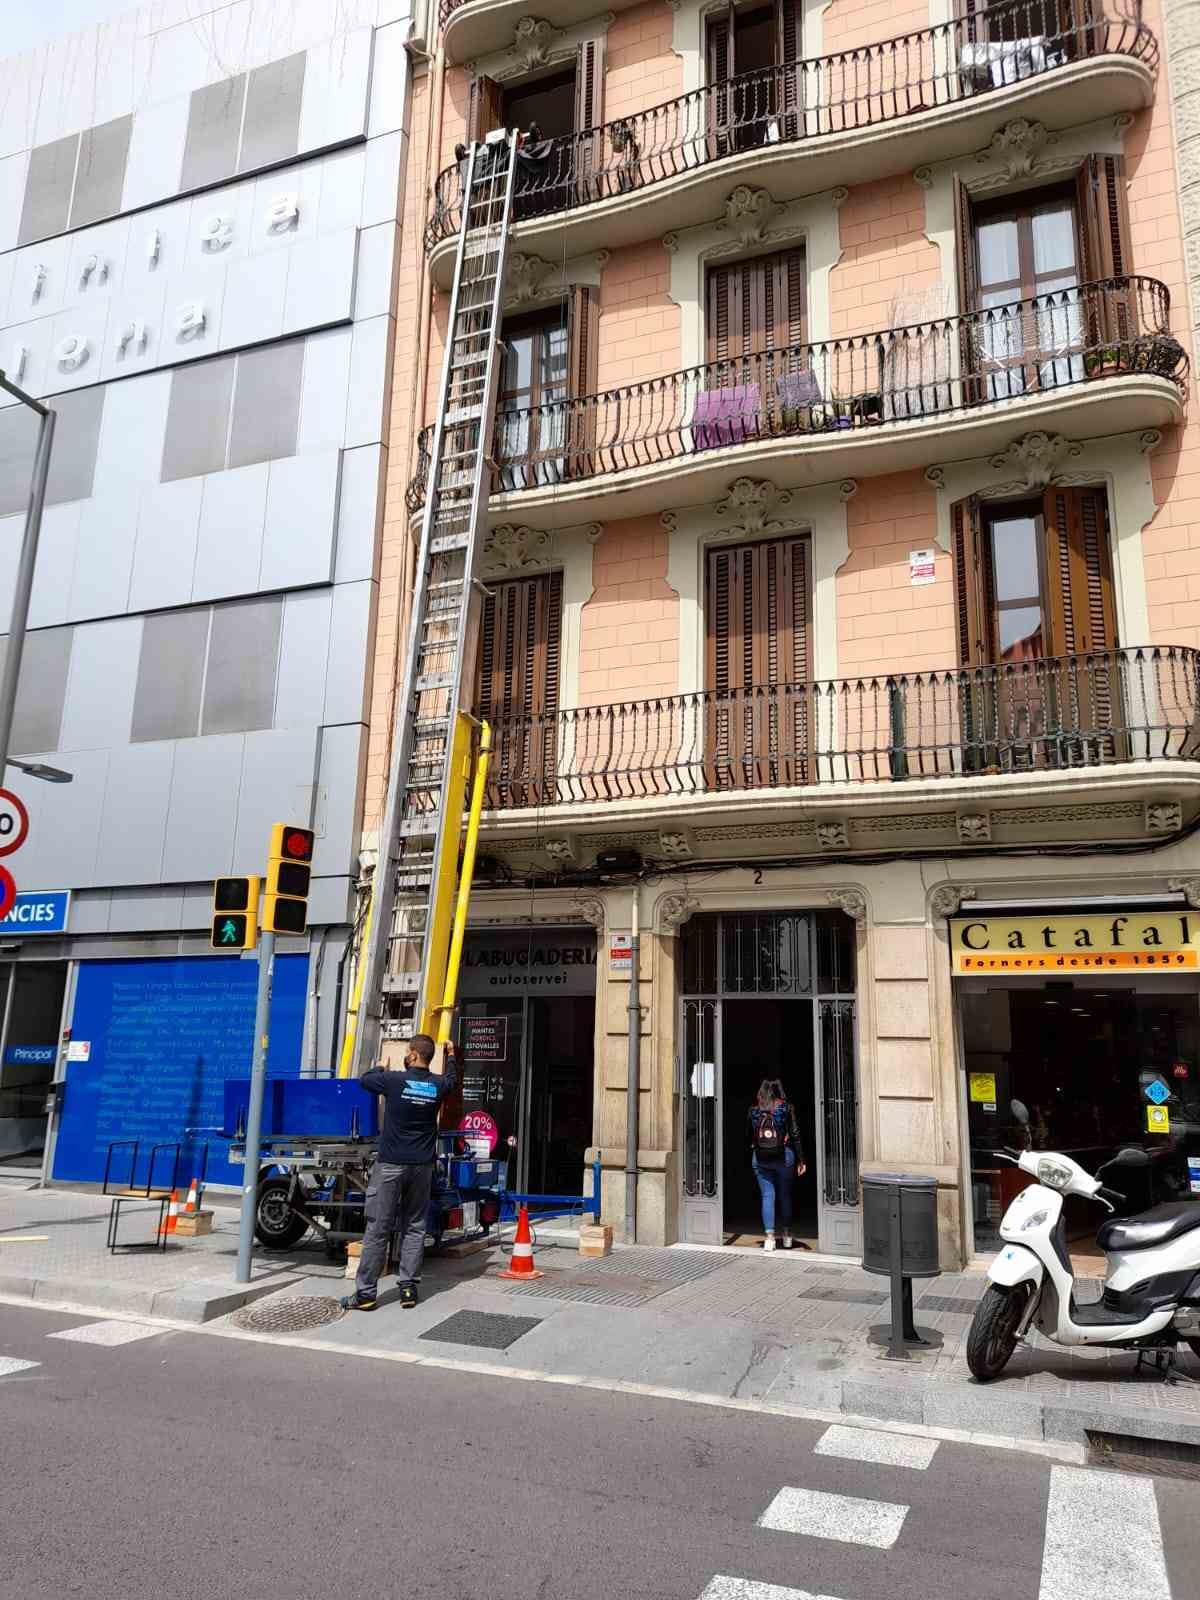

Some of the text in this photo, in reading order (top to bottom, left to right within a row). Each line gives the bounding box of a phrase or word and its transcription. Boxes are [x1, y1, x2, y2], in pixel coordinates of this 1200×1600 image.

[754, 870, 763, 885] 2
[960, 916, 1193, 950] Catafal
[965, 954, 1185, 968] Forners desde 1859
[489, 970, 567, 985] autoservei
[465, 1114, 492, 1130] 20%
